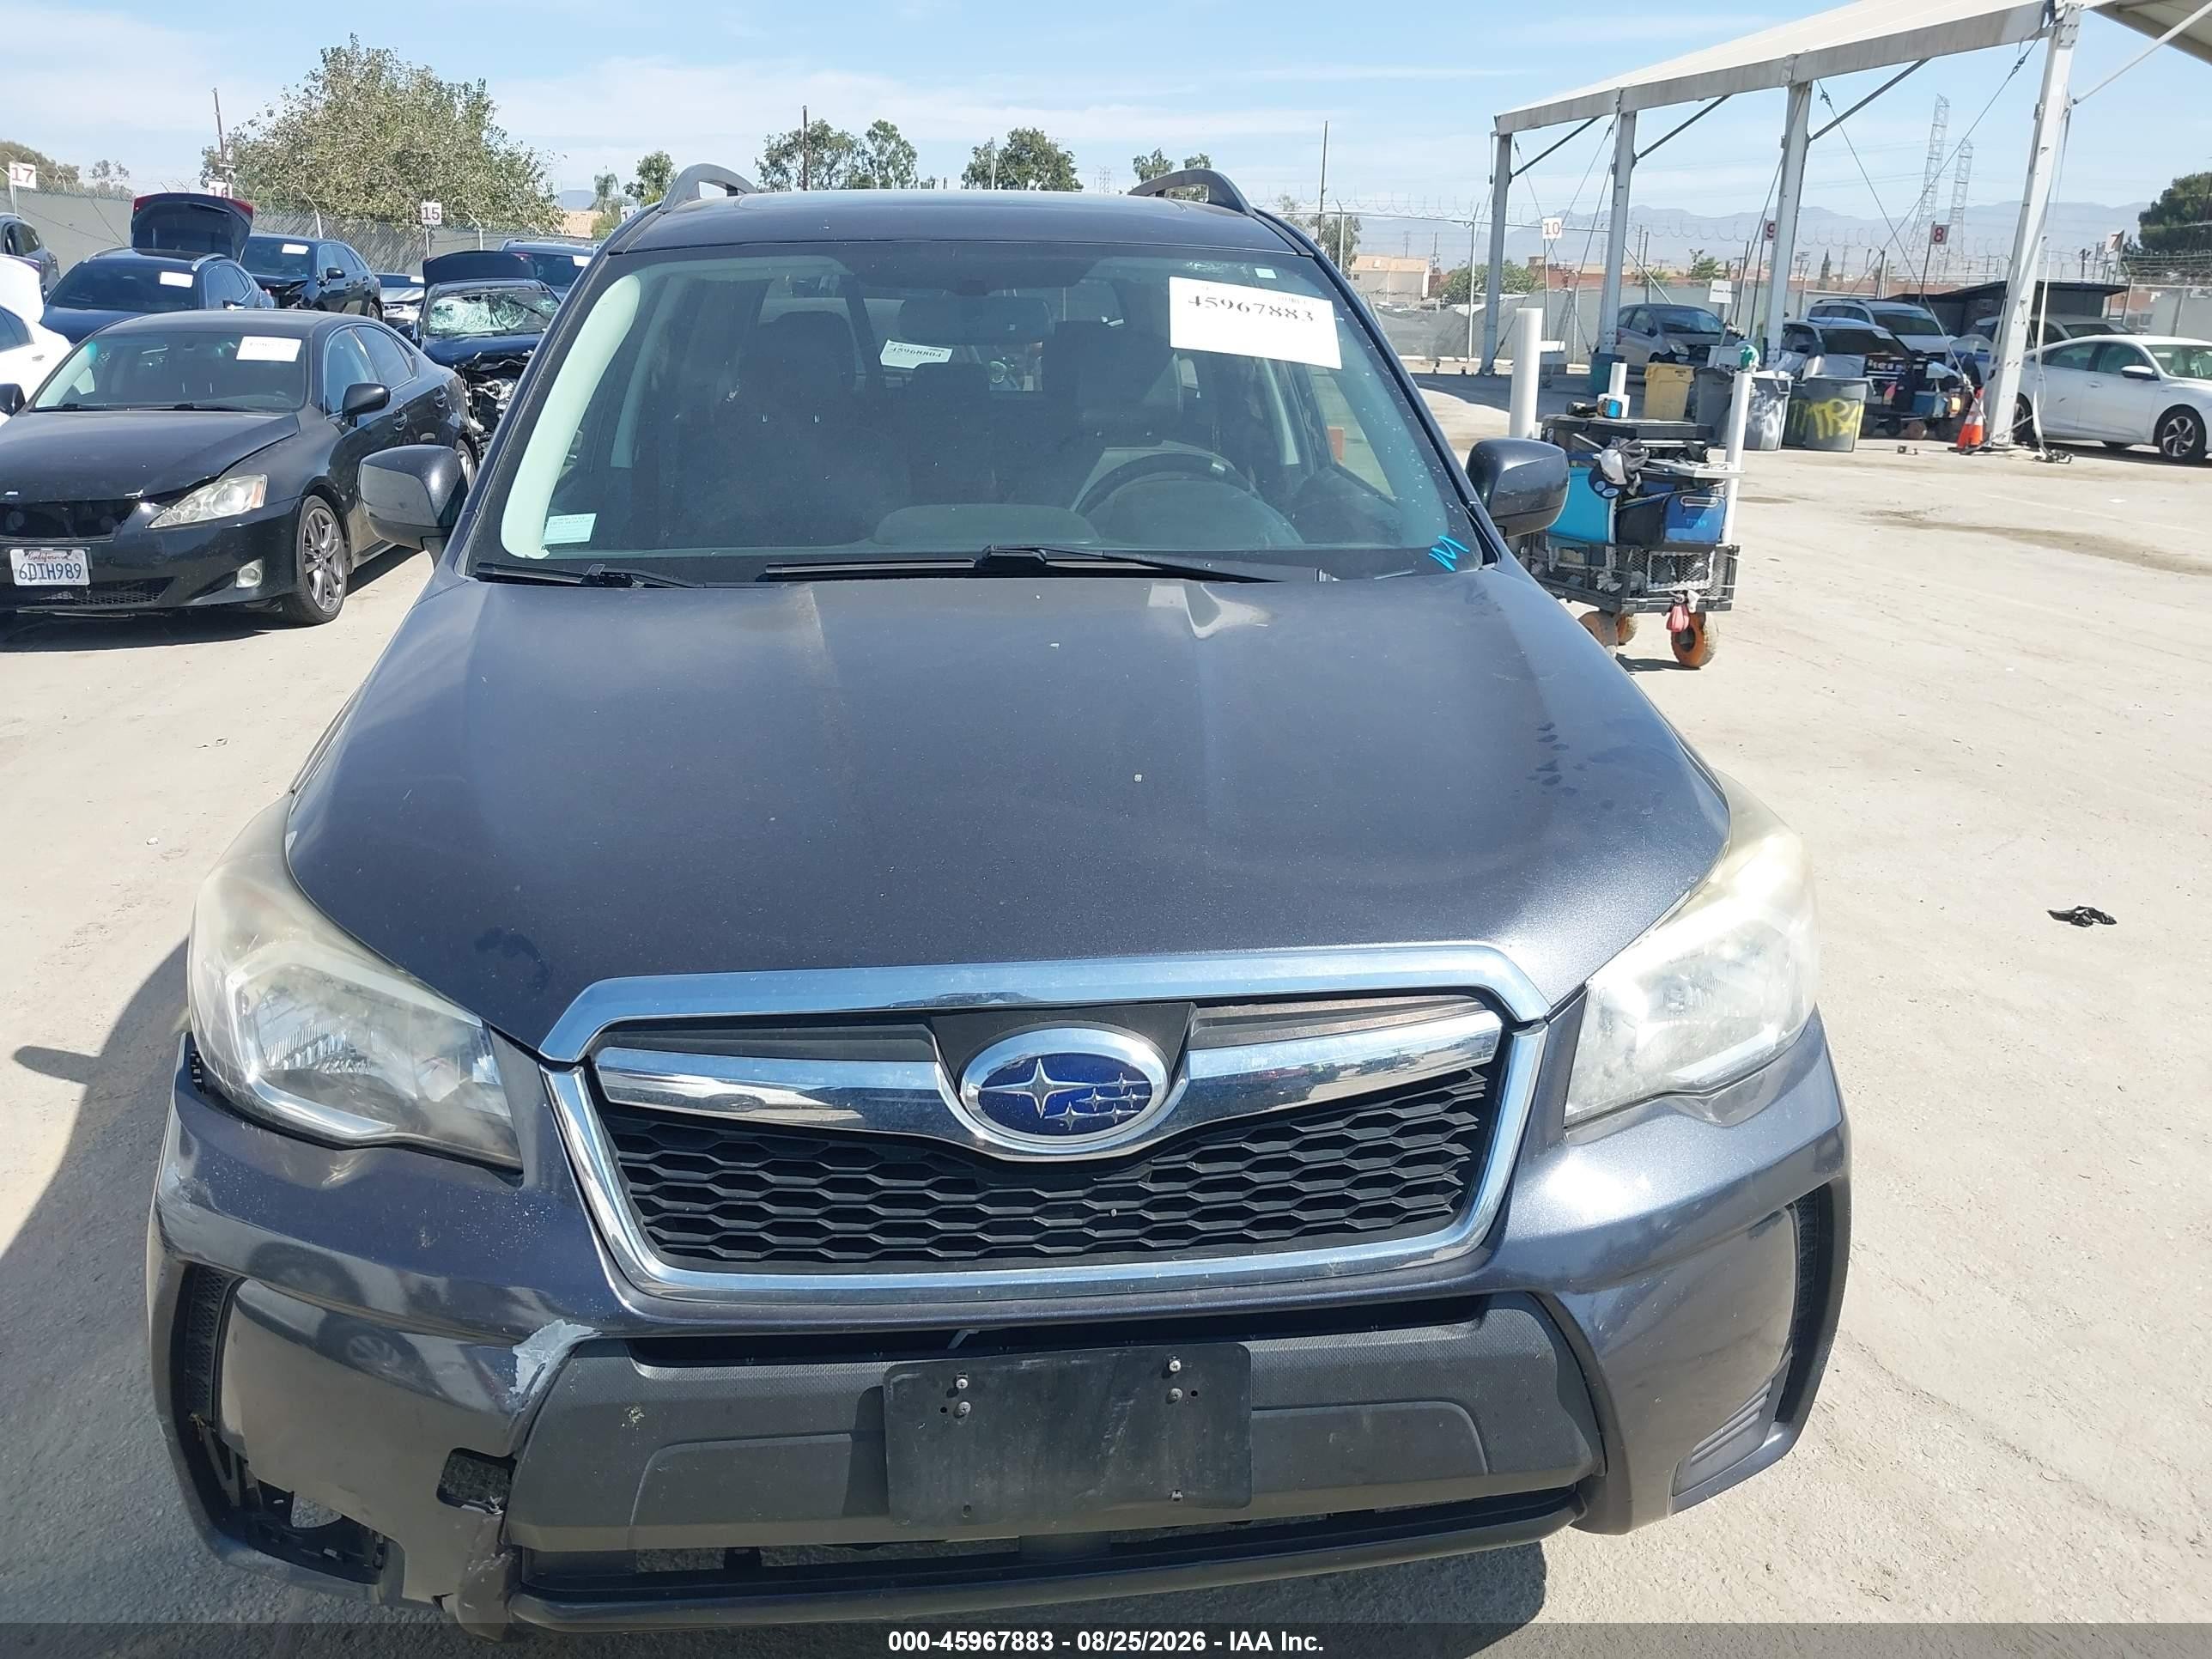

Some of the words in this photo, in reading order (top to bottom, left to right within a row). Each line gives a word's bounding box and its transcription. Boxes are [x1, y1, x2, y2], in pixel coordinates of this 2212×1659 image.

[11, 167, 33, 183] 17
[422, 206, 440, 221] 15
[1544, 222, 1559, 234] 10
[1766, 222, 1775, 239] 9
[1934, 227, 1944, 242] 8
[2111, 234, 2120, 250] 7
[1188, 295, 1315, 322] 45967883
[19, 562, 82, 580] 6DIH989
